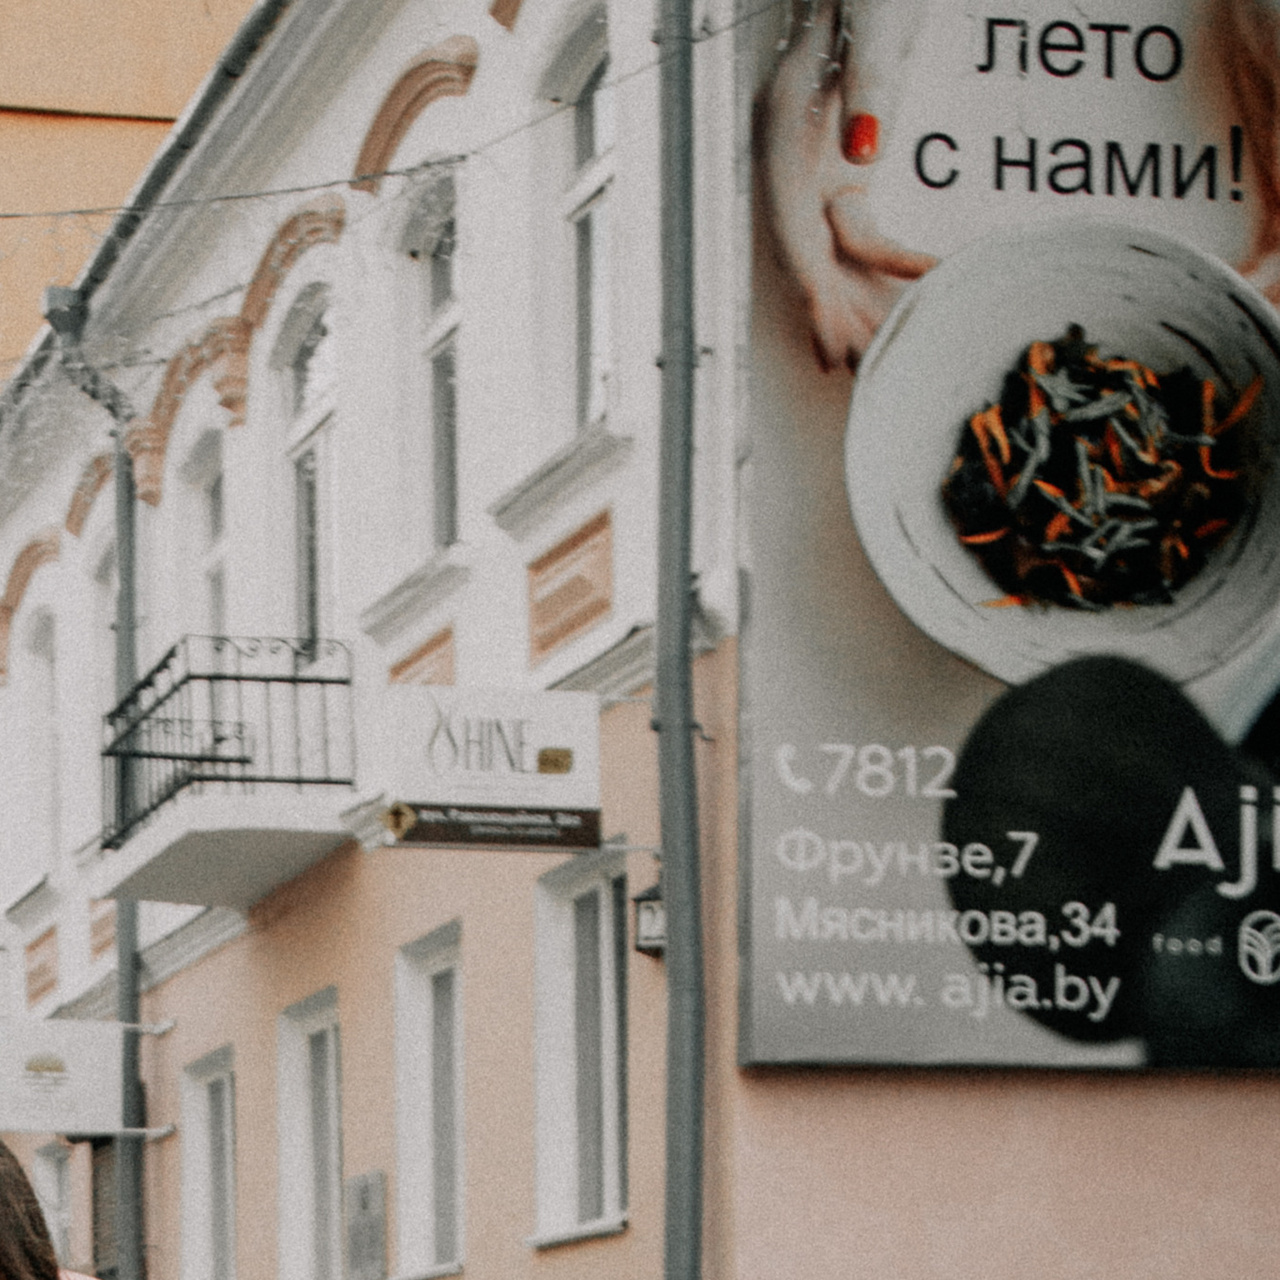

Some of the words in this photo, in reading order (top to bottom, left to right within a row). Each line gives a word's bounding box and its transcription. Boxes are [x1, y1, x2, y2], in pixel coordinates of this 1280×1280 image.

[976, 18, 1184, 82] лето
[915, 132, 960, 189] с
[994, 126, 1244, 201] нами!
[821, 743, 957, 798] 7812
